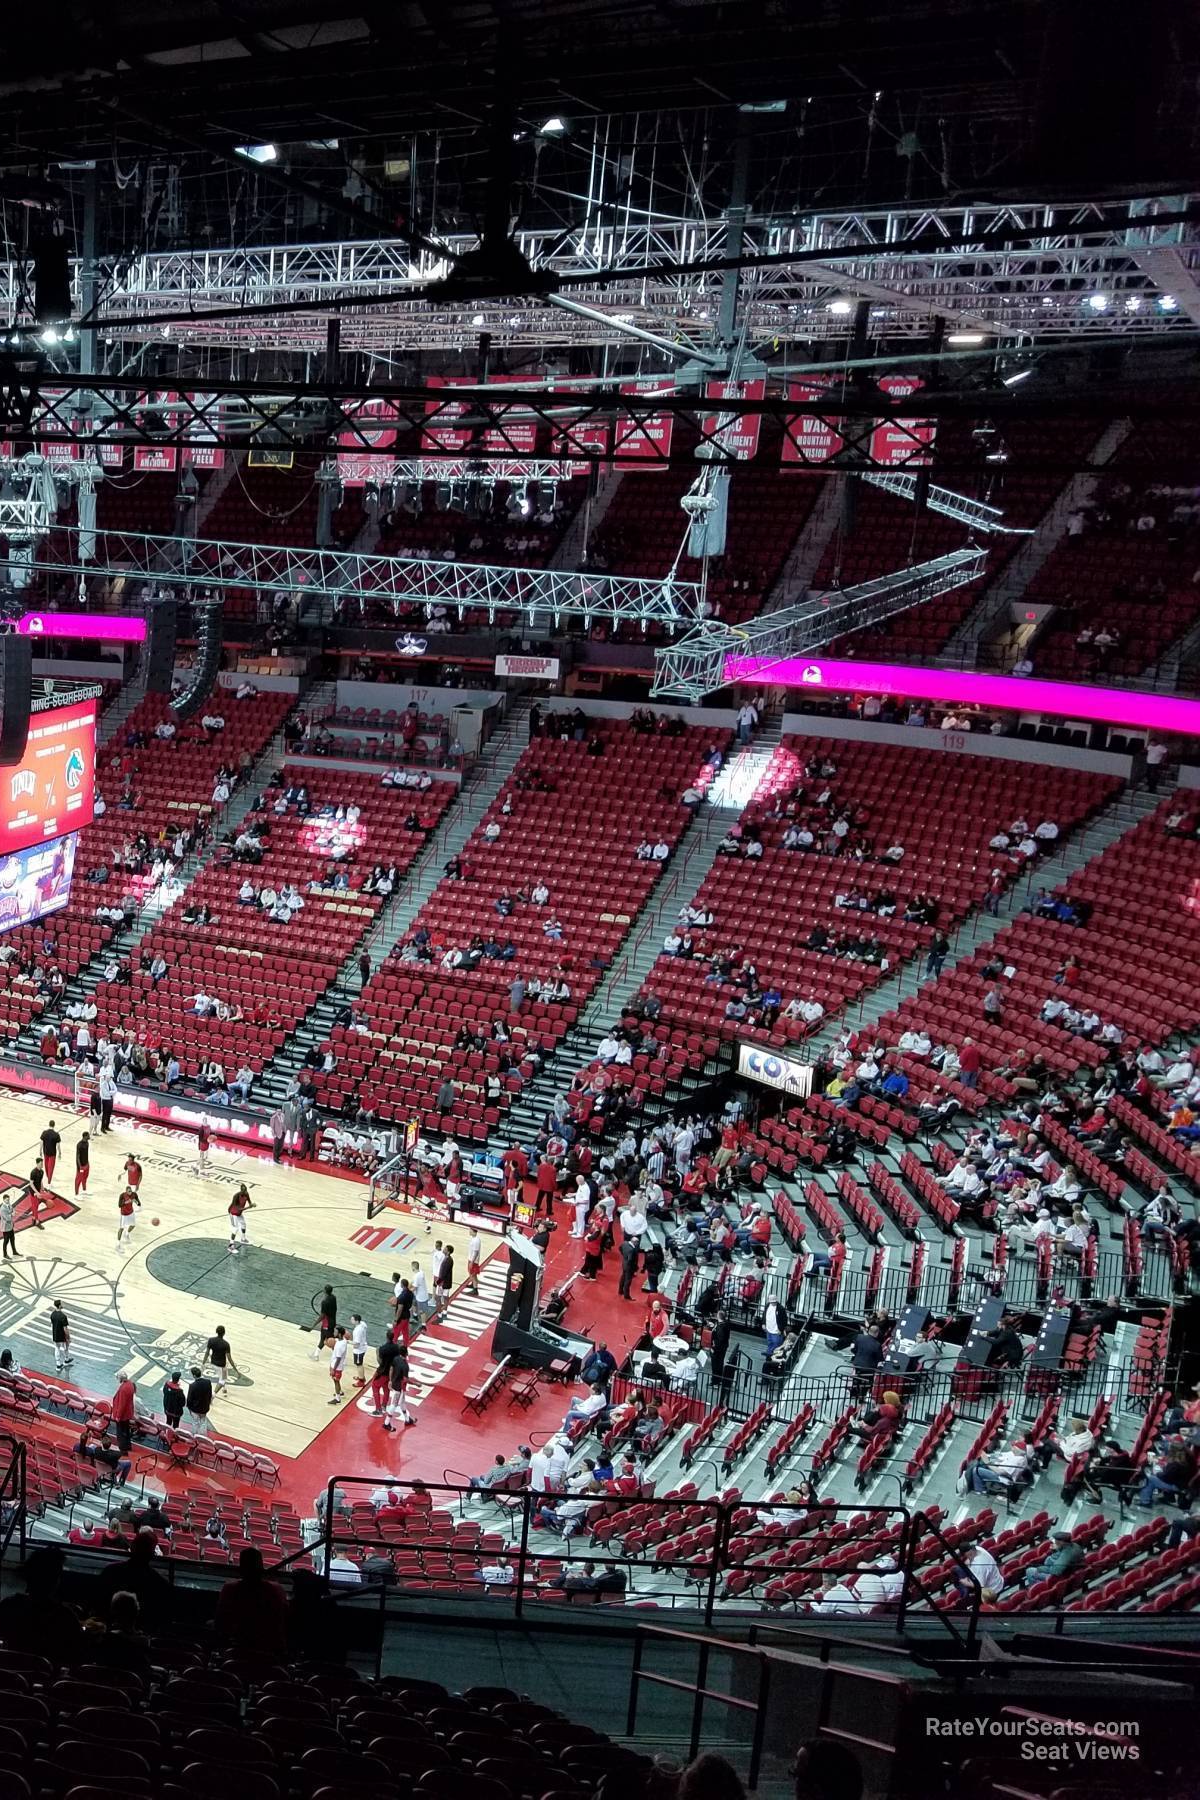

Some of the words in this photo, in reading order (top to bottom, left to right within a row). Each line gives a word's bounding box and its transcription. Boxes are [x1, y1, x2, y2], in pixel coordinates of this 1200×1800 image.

[796, 435, 831, 446] MOUNTAIN
[31, 695, 51, 713] MING
[52, 685, 103, 706] SCOREBOARD
[411, 688, 429, 701] 117
[942, 733, 965, 750] 119
[748, 1052, 799, 1086] COX
[148, 1350, 182, 1366] LAS
